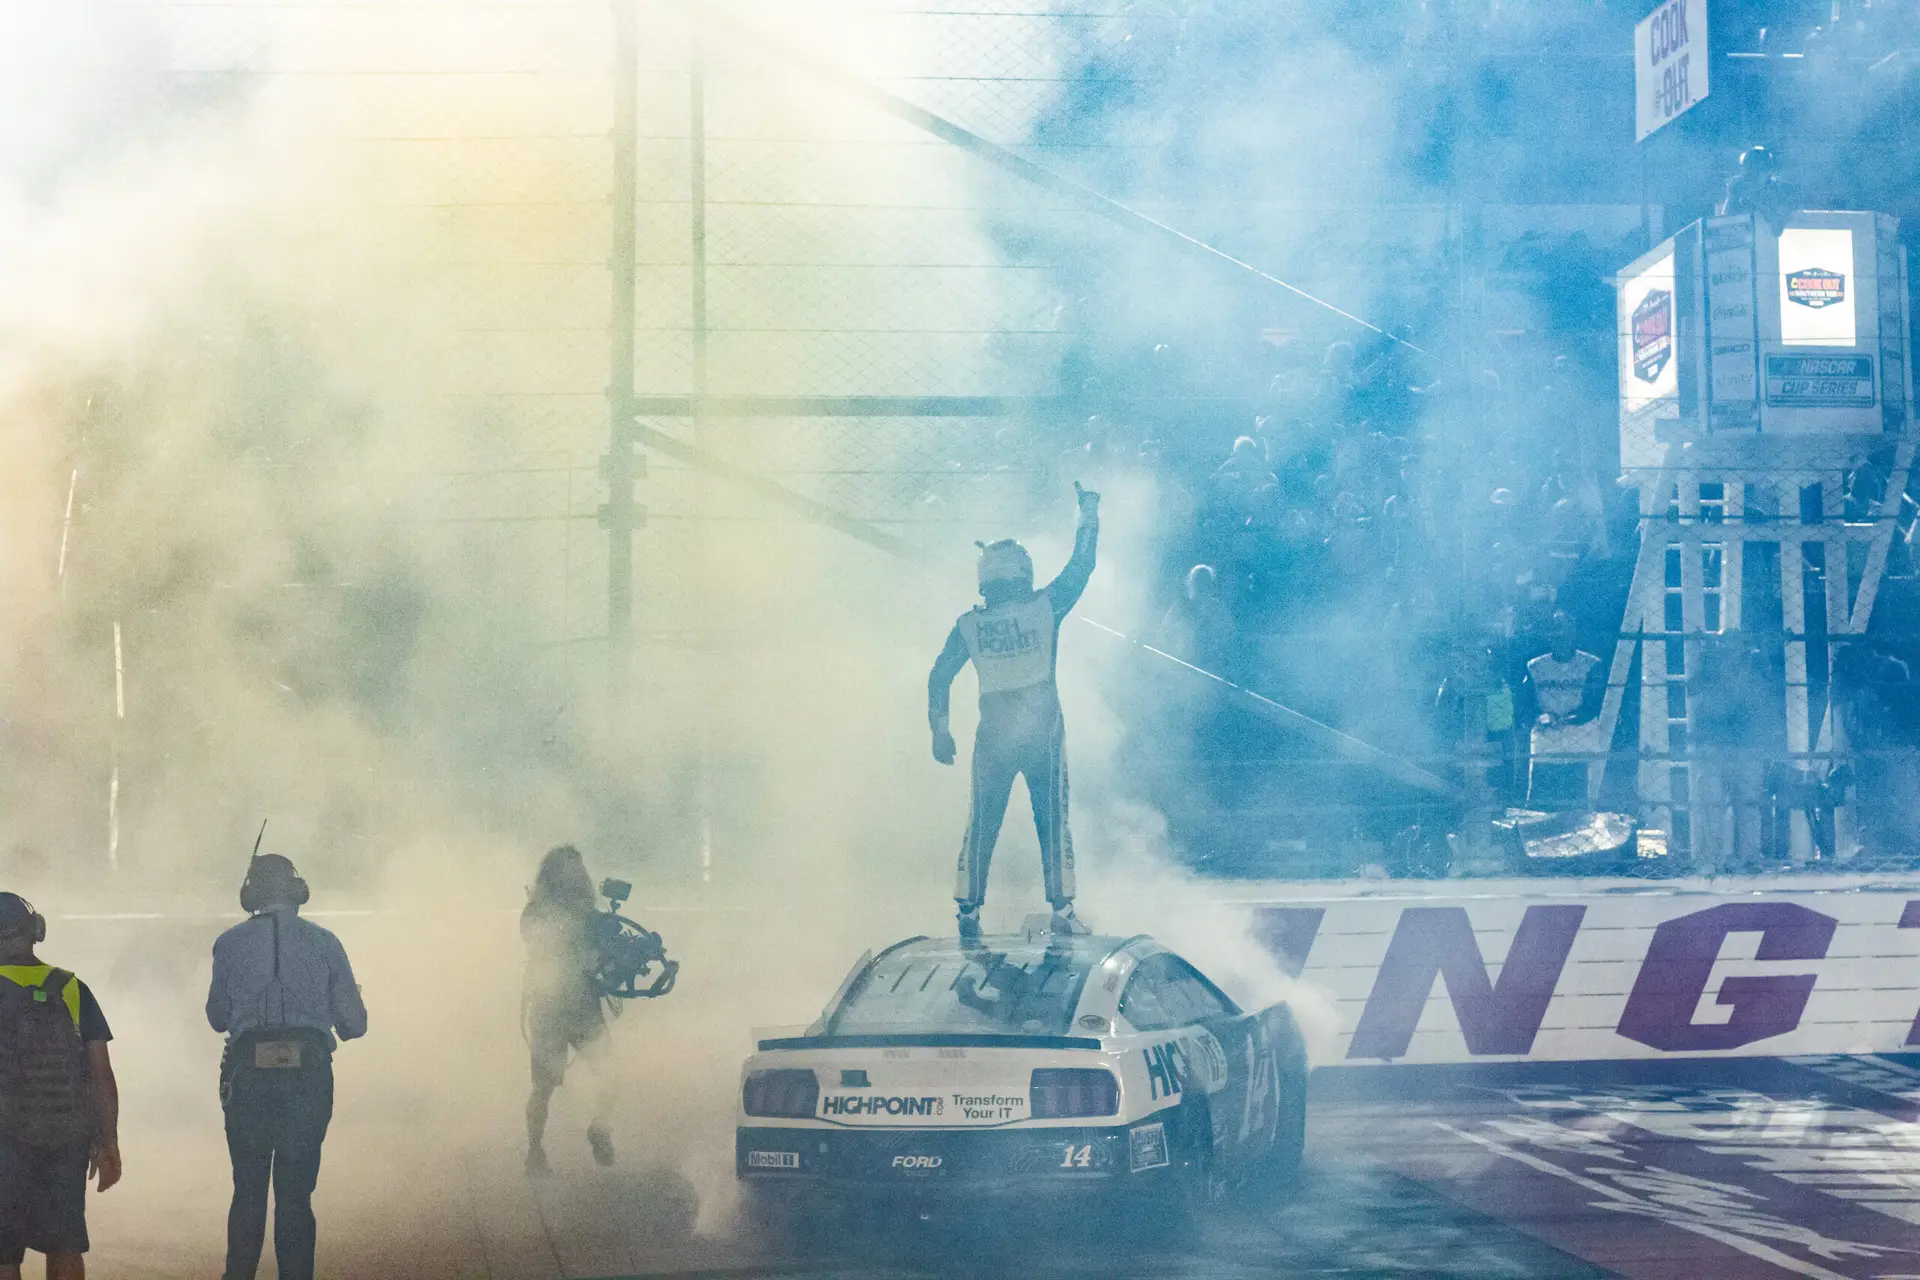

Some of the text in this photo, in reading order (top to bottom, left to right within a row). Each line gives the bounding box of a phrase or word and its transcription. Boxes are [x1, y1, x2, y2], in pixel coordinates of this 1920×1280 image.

[1651, 0, 1689, 66] COOK
[1800, 359, 1857, 375] NASCAR
[1781, 381, 1858, 395] CUP SERIES
[823, 1096, 936, 1116] HIGHPOINT
[952, 1094, 1023, 1106] Transform
[963, 1107, 1012, 1119] Your IT
[750, 1152, 781, 1165] Mobil
[891, 1155, 943, 1168] FORD
[1060, 1144, 1091, 1168] 14
